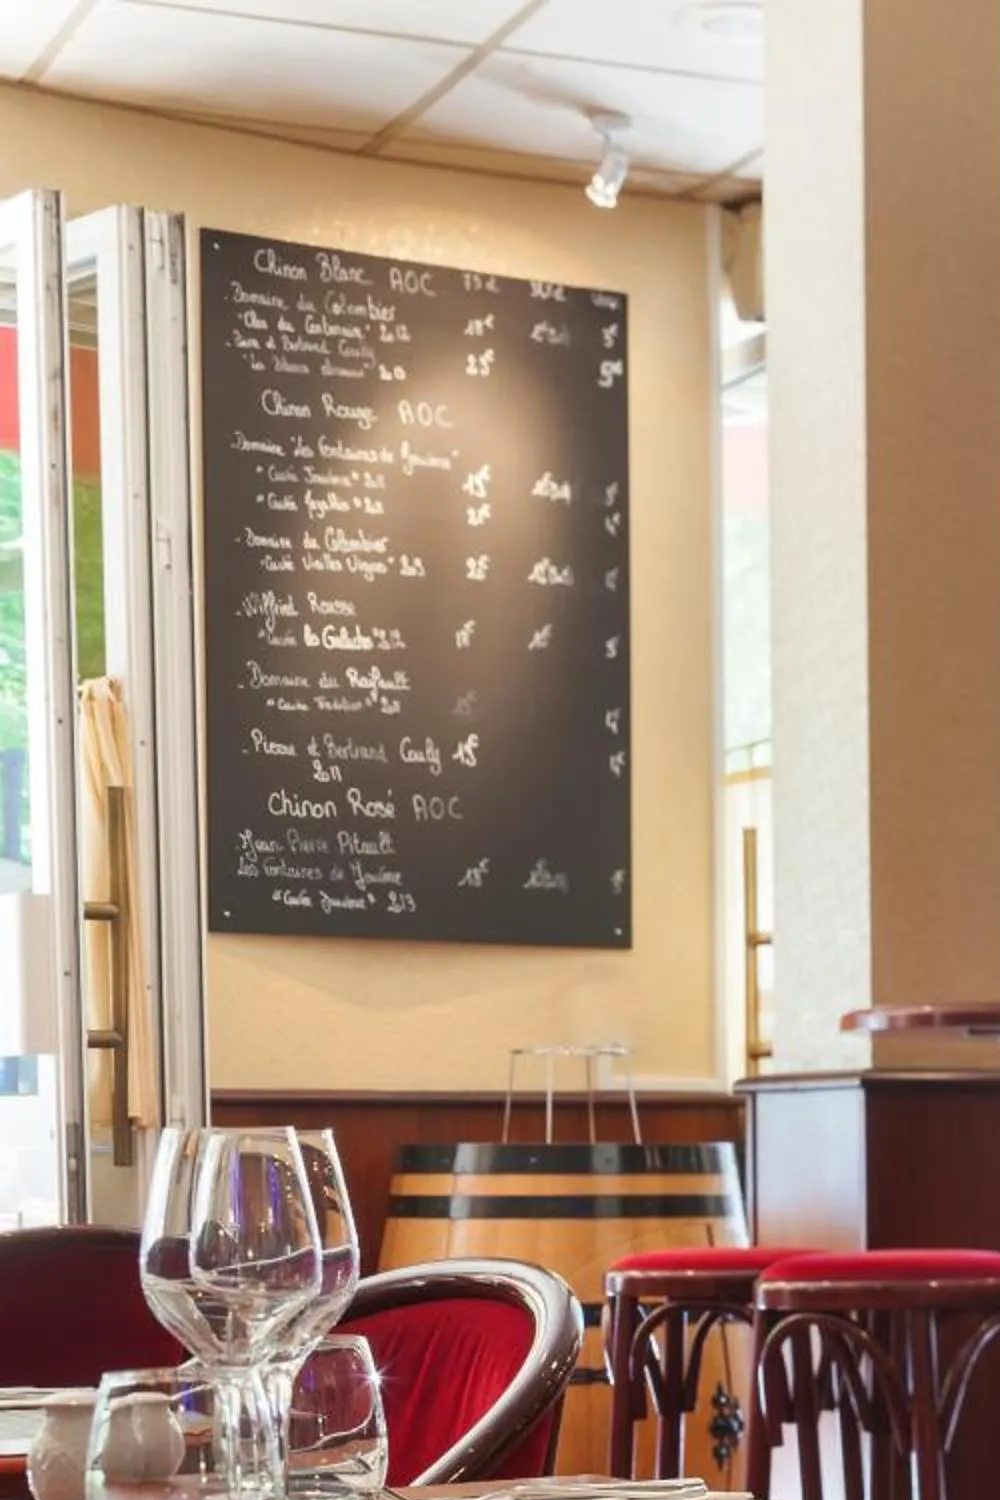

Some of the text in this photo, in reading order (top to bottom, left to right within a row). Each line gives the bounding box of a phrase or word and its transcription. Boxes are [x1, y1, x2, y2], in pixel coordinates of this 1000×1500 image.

[390, 266, 436, 297] AOC
[397, 399, 455, 429] AOC
[267, 787, 464, 822] Chinon Rosé AOC
